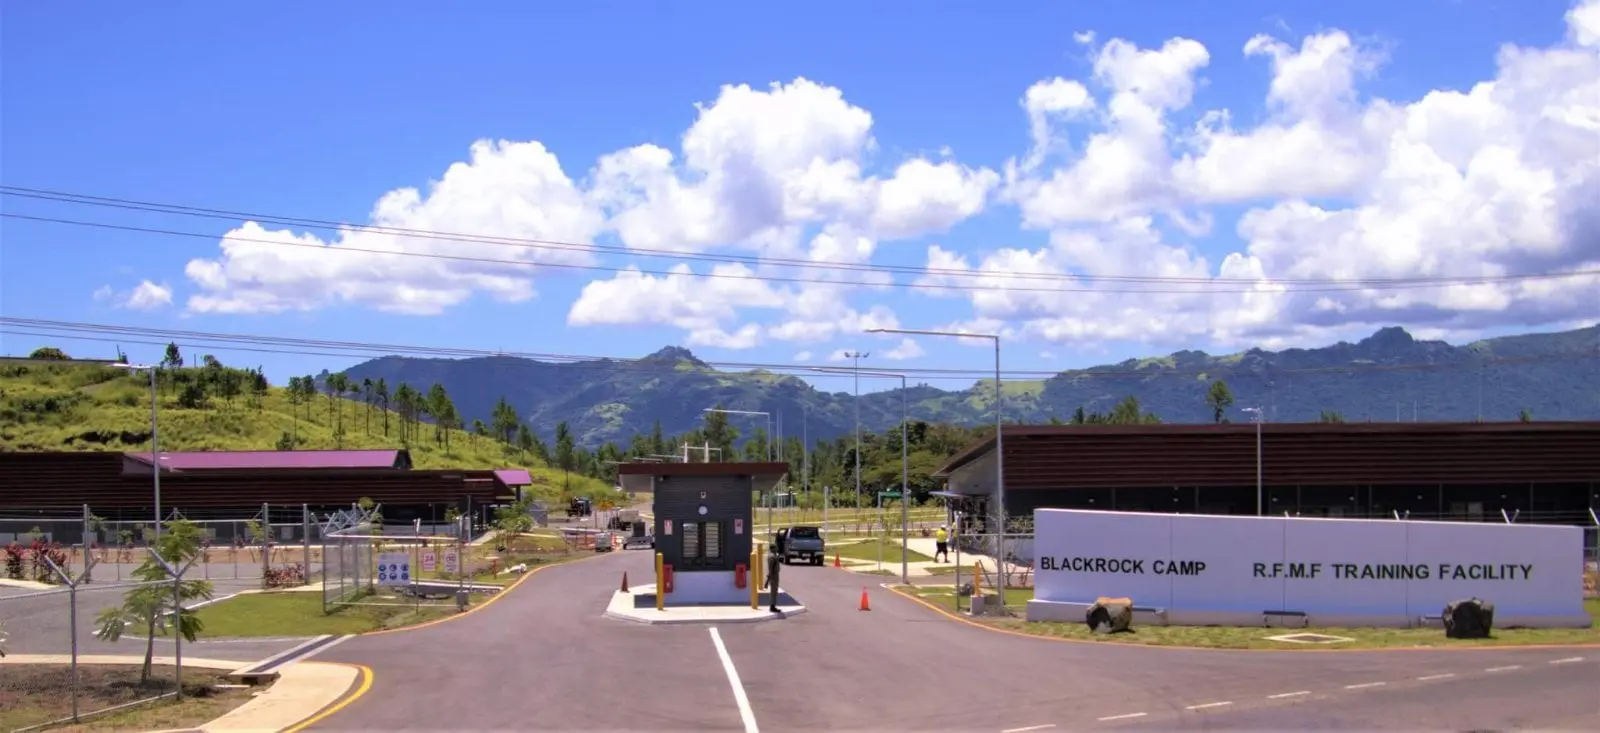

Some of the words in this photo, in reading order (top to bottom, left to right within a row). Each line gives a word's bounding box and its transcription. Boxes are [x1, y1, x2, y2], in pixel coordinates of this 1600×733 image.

[1041, 556, 1145, 574] BLACKROCK
[1152, 560, 1207, 576] CAMP
[1252, 562, 1322, 580] R.F.M.F
[1330, 563, 1430, 581] TRAINING
[1438, 563, 1533, 581] FACILITY
